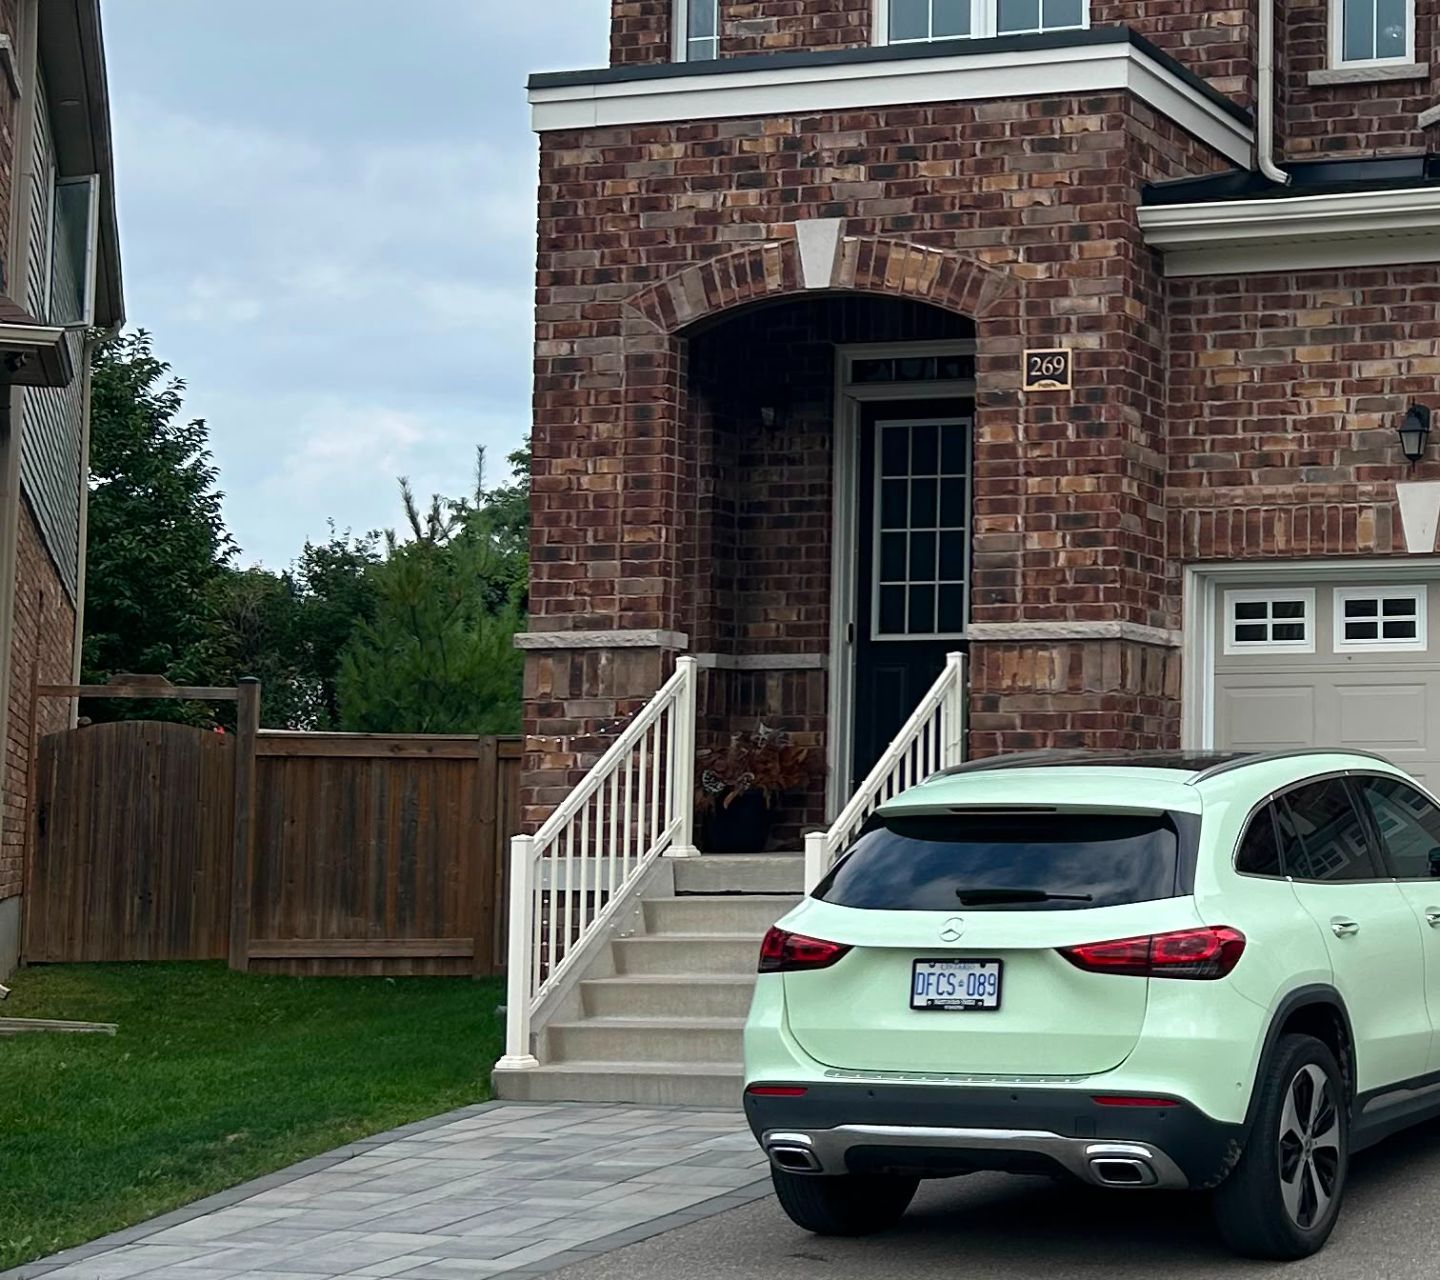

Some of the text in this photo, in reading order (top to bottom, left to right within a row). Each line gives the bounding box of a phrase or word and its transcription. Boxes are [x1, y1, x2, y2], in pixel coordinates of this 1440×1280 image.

[1030, 356, 1065, 376] 269
[915, 972, 997, 997] DFCS 089
